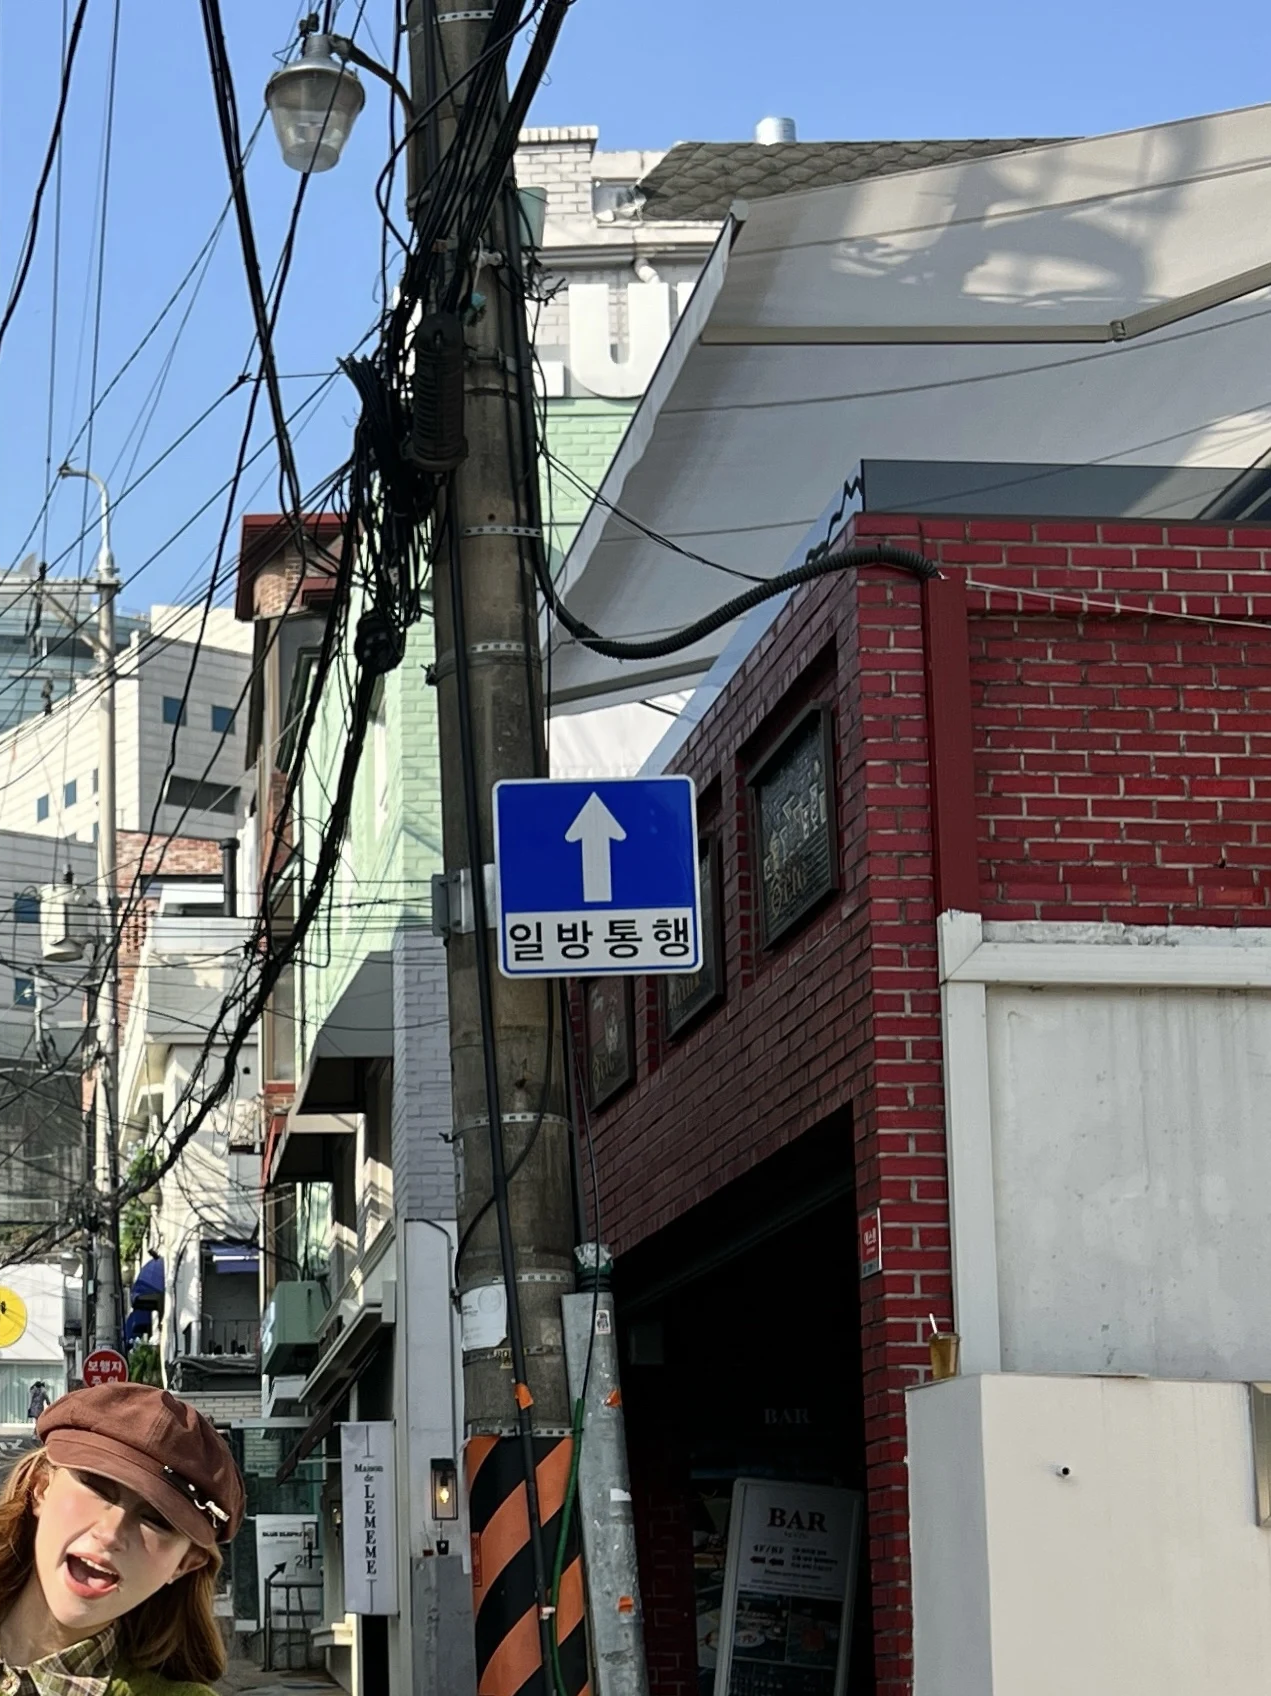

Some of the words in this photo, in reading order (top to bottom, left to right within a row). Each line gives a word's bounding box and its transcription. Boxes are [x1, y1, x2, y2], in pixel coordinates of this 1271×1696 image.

[509, 917, 690, 962] 일방통행
[88, 1359, 123, 1374] 보행자
[764, 1407, 813, 1425] BAR
[354, 1463, 384, 1473] Maison
[364, 1484, 377, 1575] LEMEME
[767, 1507, 828, 1533] BAR
